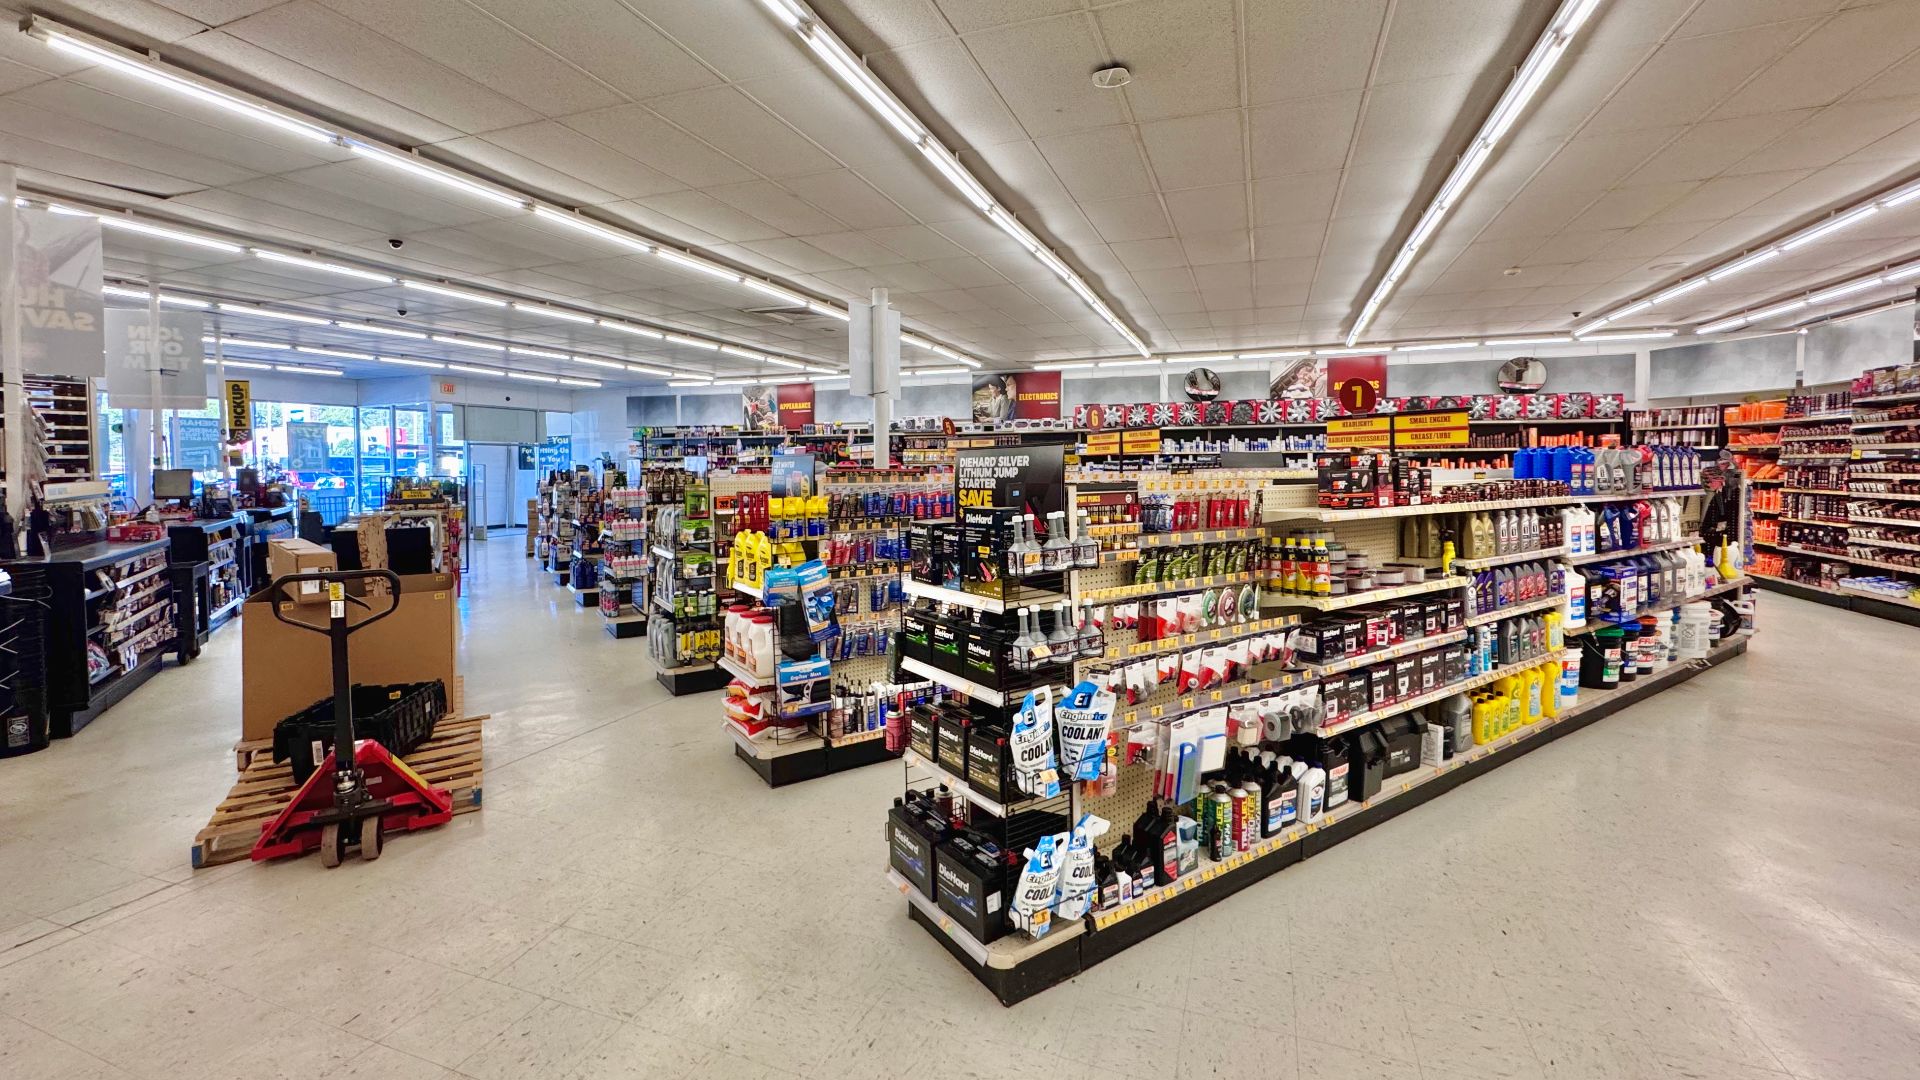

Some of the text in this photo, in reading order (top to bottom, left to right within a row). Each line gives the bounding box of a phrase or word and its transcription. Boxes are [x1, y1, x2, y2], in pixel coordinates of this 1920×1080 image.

[443, 384, 454, 393] EXIT
[1018, 391, 1059, 401] ELECTRONICS
[231, 383, 247, 428] PICKUP
[779, 402, 812, 410] APPEARANCE
[1091, 409, 1099, 427] 6
[1342, 420, 1374, 428] HEADLIGHTS
[1409, 415, 1452, 425] SMALL ENGINE
[945, 419, 952, 434] 5
[552, 436, 569, 444] You
[1353, 434, 1389, 442] ACCESSORIES
[1410, 432, 1452, 440] GREASE/LUBE
[959, 455, 1030, 468] DIEHARD SILVER
[959, 467, 1019, 478] LITHIUM JUMP
[958, 478, 996, 489] STARTER
[958, 489, 993, 507] SAVE
[959, 507, 965, 519] $
[965, 513, 993, 525] DieHard
[906, 618, 925, 632] DieHard
[934, 627, 955, 640] DieHard
[967, 642, 991, 658] DieHard
[911, 719, 928, 734] DieHard
[1062, 725, 1105, 740] COOLANT
[939, 726, 959, 742] DieHard
[969, 745, 993, 762] DieHard
[1021, 736, 1053, 762] COOLA
[1241, 797, 1249, 850] TRUFUEL
[894, 826, 919, 855] DieHard
[938, 862, 970, 894] DieHard
